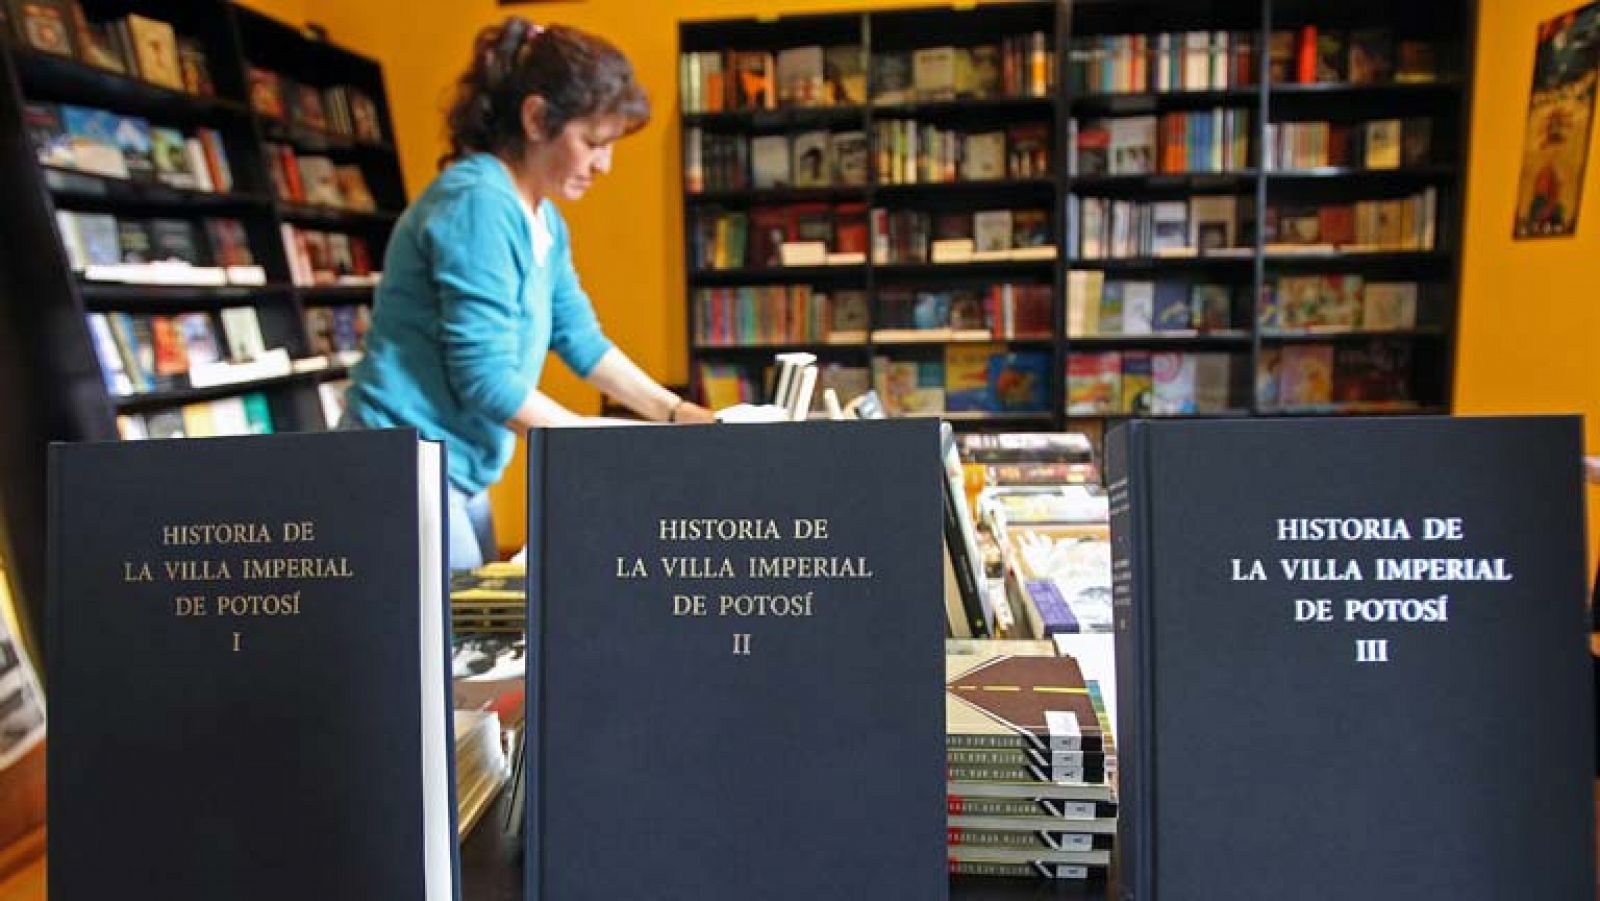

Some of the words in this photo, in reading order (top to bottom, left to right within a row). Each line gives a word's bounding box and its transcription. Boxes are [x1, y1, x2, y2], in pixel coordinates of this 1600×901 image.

[163, 523, 271, 545] HISTORIA
[283, 521, 315, 542] DE
[659, 518, 781, 541] HISTORIA
[793, 518, 829, 540] DE
[1276, 517, 1412, 541] HISTORIA
[1422, 517, 1463, 541] DE
[124, 562, 153, 581] LA
[164, 560, 232, 581] VILLA
[243, 557, 354, 580] IMPERIAL
[616, 556, 648, 579] LA
[660, 556, 735, 579] VILLA
[750, 556, 873, 579] IMPERIAL
[1231, 558, 1267, 581] LA
[1279, 558, 1363, 581] VILLA
[1375, 558, 1513, 581] IMPERIAL
[175, 596, 206, 616] DE
[218, 590, 301, 616] POTOSÍ
[673, 594, 707, 616] DE
[719, 591, 814, 617] POTOSÍ
[1294, 599, 1334, 622] DE
[1344, 594, 1449, 622] POTOSÍ
[232, 631, 241, 652] I
[732, 633, 752, 655] II
[1355, 639, 1389, 662] III
